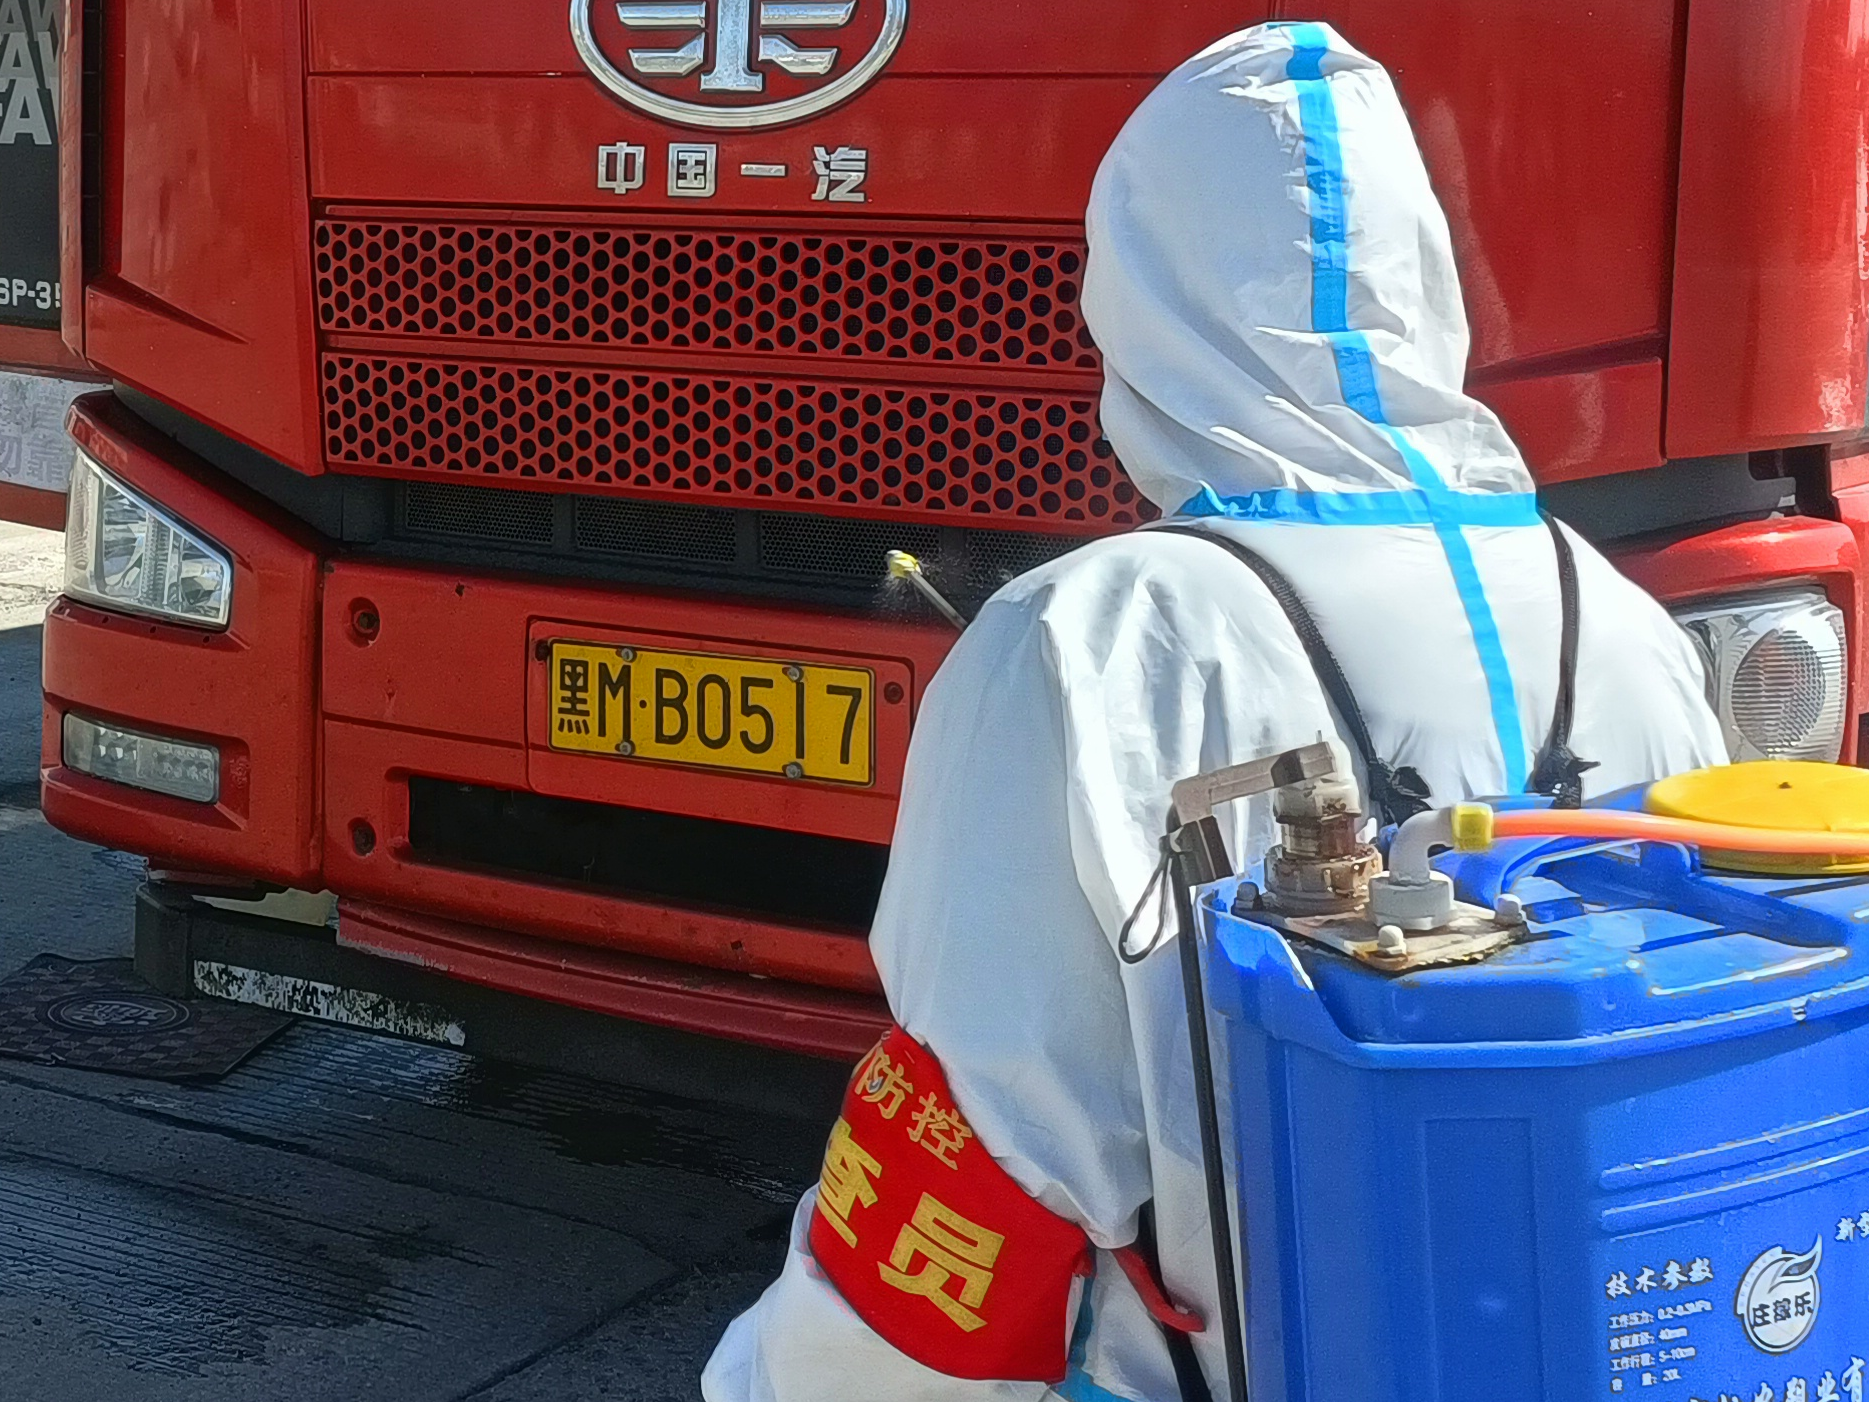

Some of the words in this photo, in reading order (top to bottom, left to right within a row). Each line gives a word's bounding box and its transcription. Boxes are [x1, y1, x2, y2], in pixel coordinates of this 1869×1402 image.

[597, 141, 869, 203] 中国一汽
[852, 1041, 973, 1171] 防控
[1605, 1257, 1714, 1298] 技术参数
